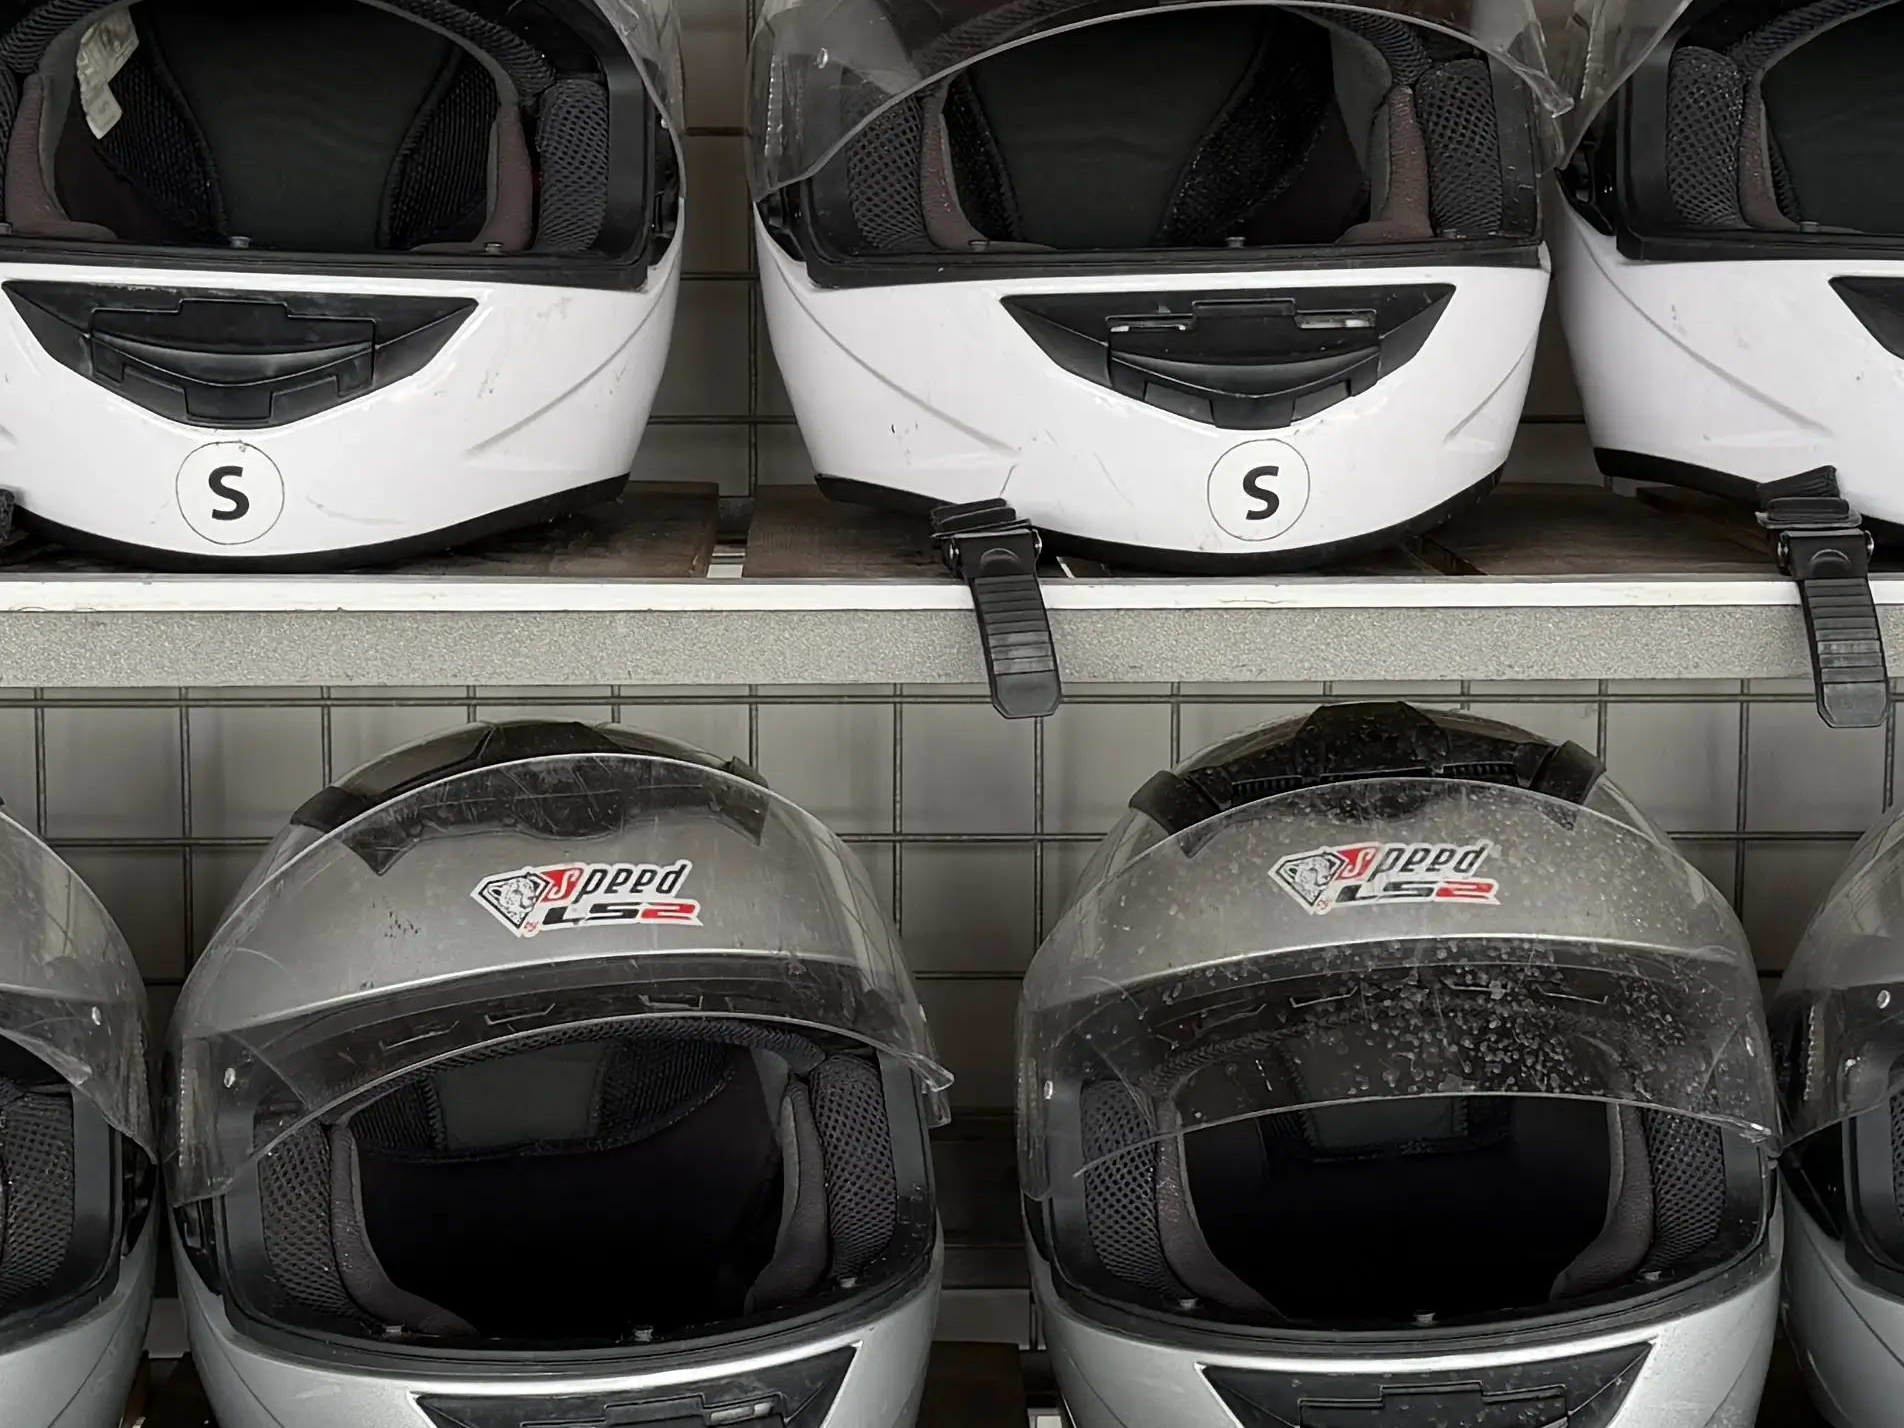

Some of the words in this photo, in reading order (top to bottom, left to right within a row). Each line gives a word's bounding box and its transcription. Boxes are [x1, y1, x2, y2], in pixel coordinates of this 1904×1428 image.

[209, 466, 249, 520] S
[1243, 466, 1279, 520] S
[1334, 846, 1490, 882] Speed
[540, 863, 688, 904] Speed
[1335, 881, 1495, 903] LS2
[541, 902, 696, 926] LS2
